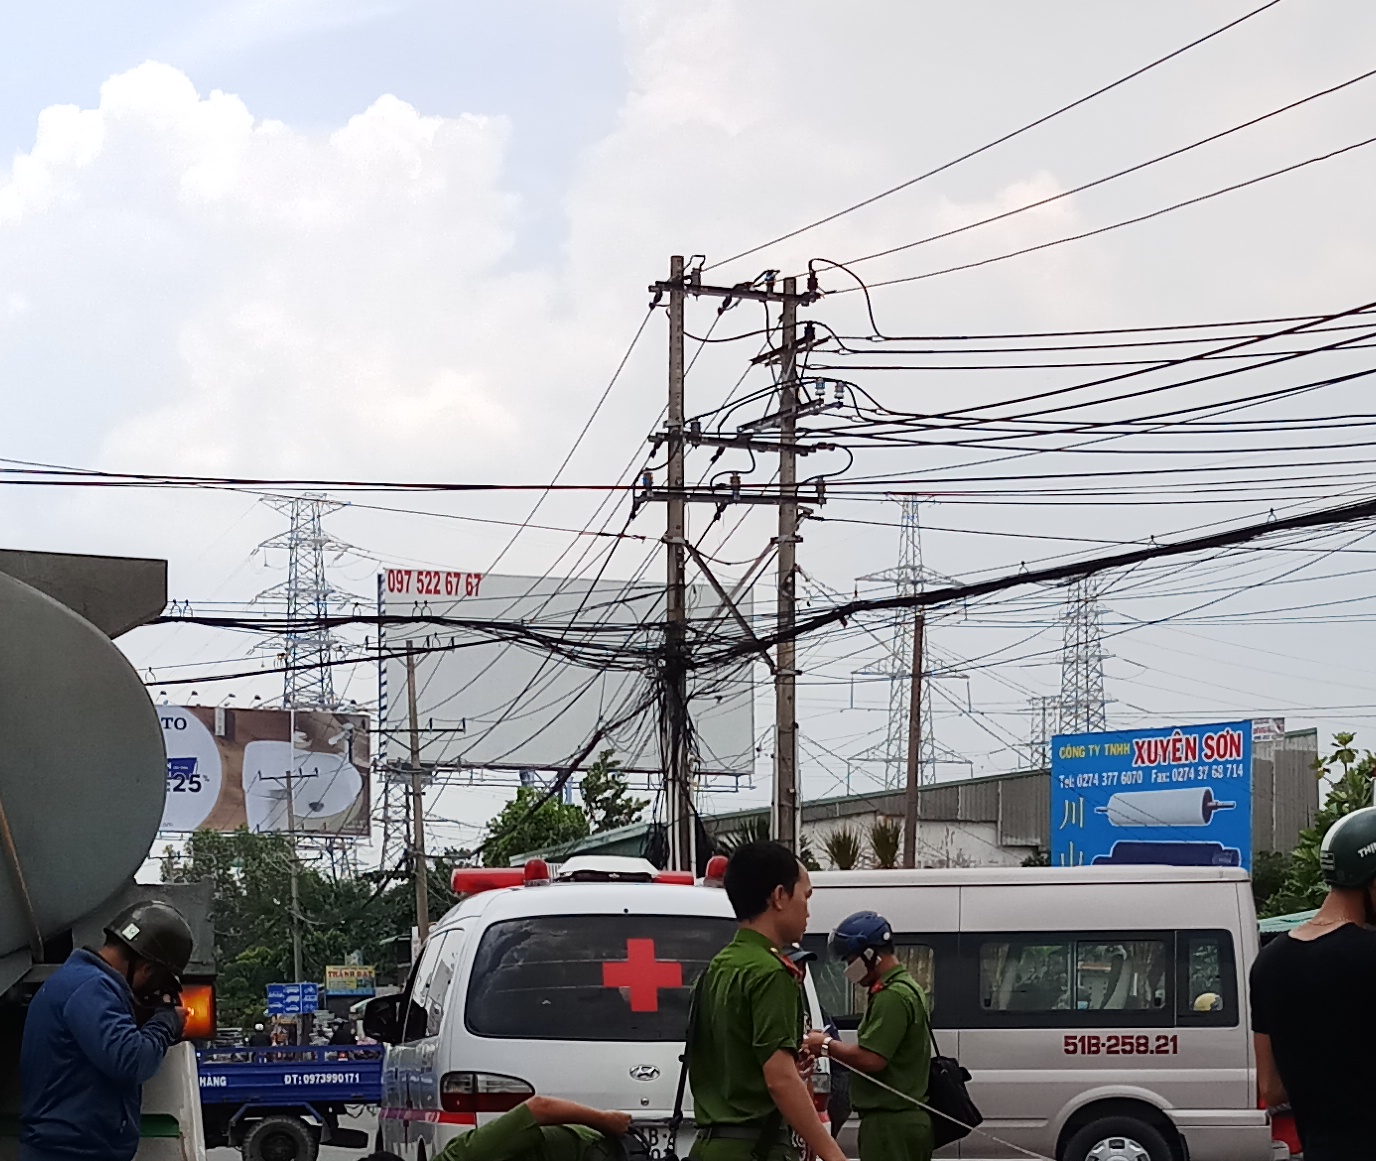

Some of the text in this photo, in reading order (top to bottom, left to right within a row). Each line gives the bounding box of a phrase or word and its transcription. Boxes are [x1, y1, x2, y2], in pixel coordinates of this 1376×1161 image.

[387, 569, 482, 597] 097 522 67 67
[1059, 743, 1085, 759] CÔNG
[1088, 745, 1100, 757] TY
[1104, 743, 1131, 755] TNHH
[1133, 731, 1198, 766] XUYÊN
[1203, 729, 1242, 760] SƠN
[1076, 773, 1099, 788] 0274
[1102, 771, 1119, 786] 377
[1120, 770, 1143, 785] 6070
[1172, 766, 1195, 782] 0274
[1226, 763, 1244, 778] 714
[1063, 1034, 1178, 1055] 51B-258.21
